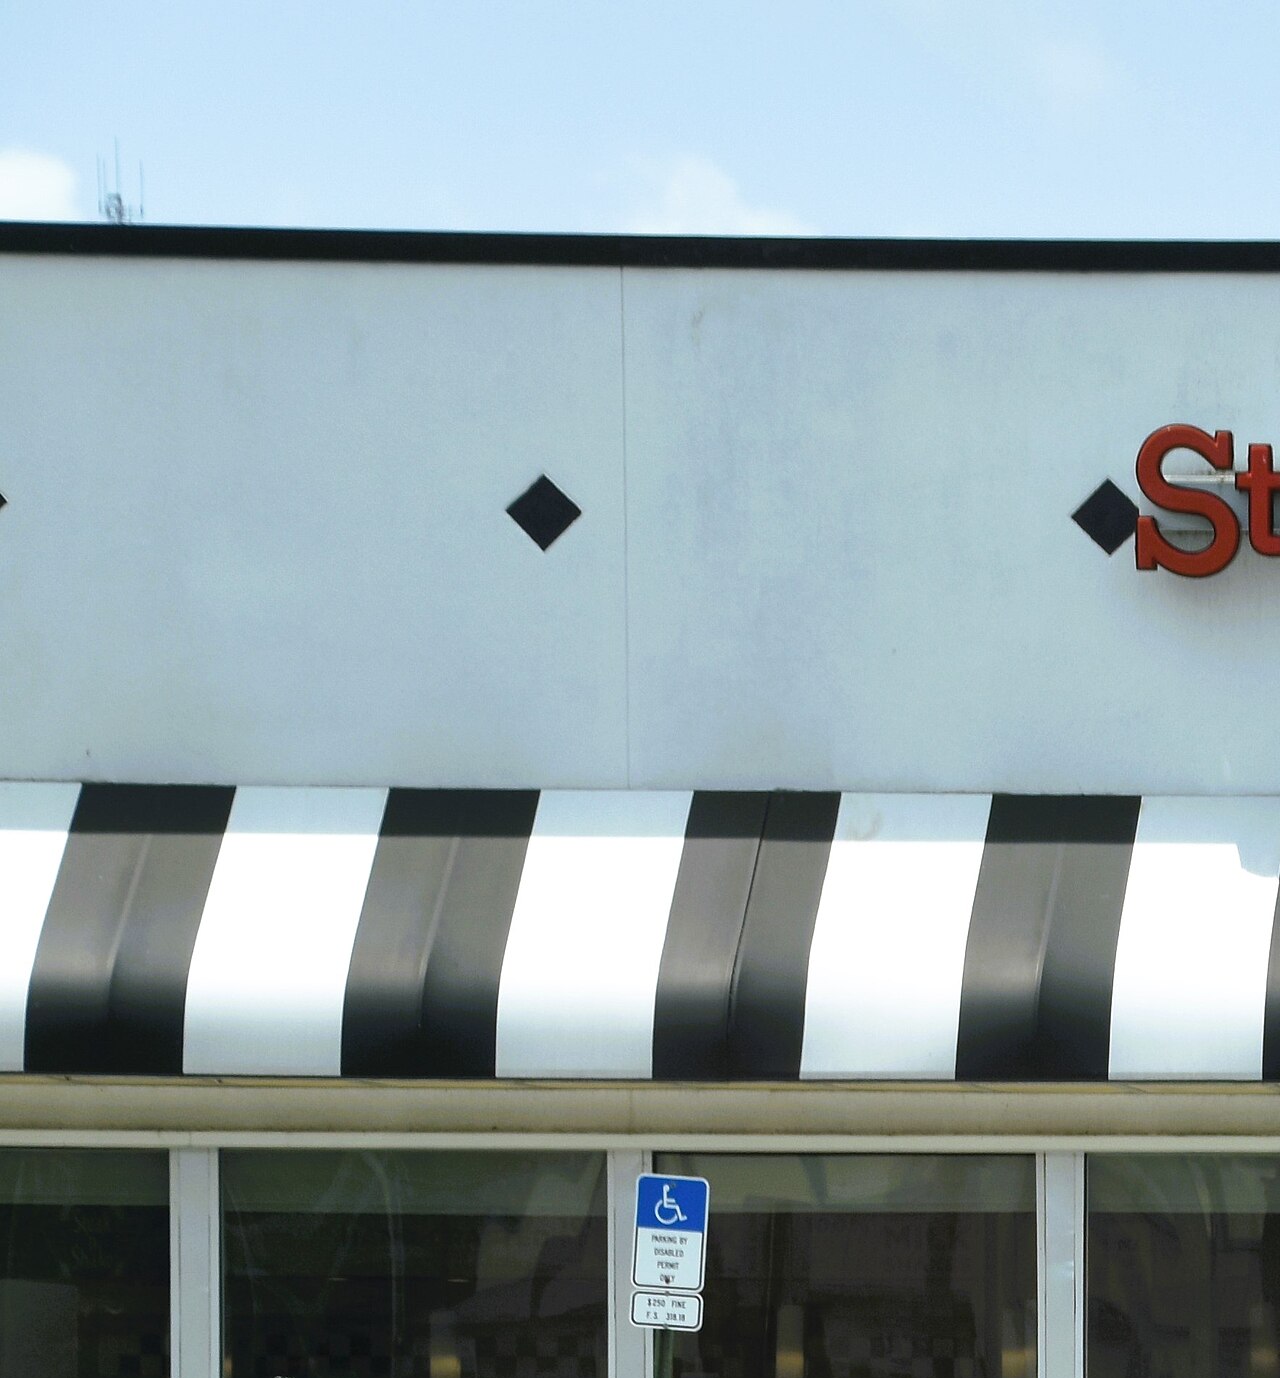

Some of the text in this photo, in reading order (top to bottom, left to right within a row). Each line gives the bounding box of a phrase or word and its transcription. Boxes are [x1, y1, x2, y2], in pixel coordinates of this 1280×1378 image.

[651, 1235, 688, 1245] PARKING BY
[654, 1248, 684, 1258] DISABLED
[657, 1261, 680, 1270] PERMIT
[647, 1298, 687, 1309] $250 FINE
